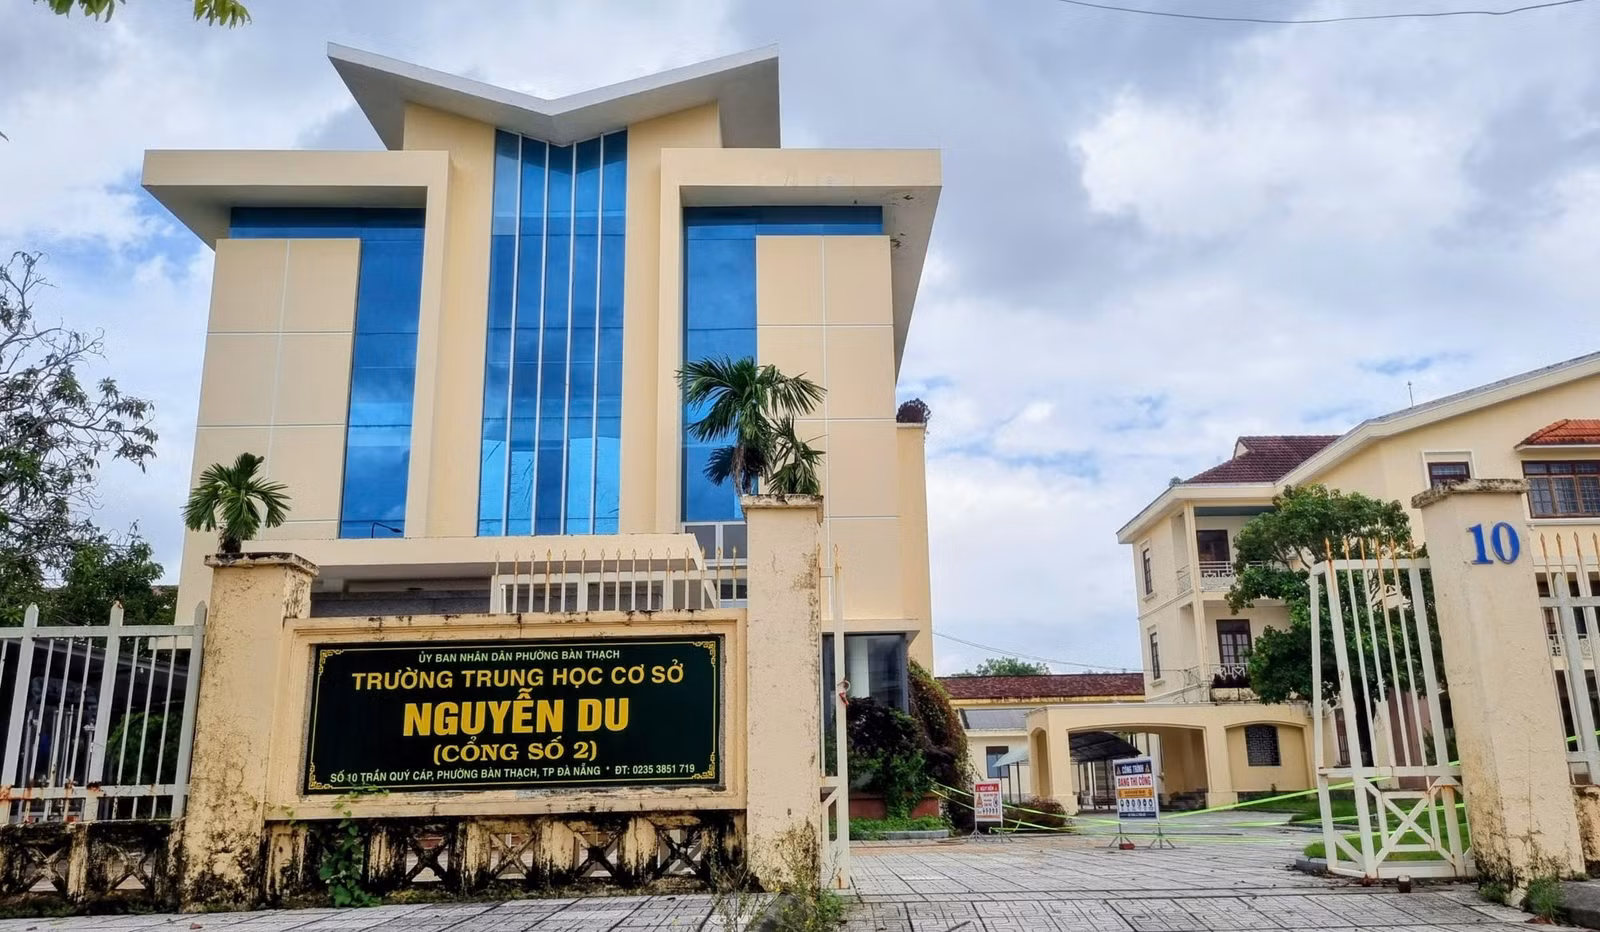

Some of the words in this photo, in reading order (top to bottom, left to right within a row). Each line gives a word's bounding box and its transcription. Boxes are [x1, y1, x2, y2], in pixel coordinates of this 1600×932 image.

[1466, 522, 1520, 565] 10
[418, 651, 433, 664] ỦY
[435, 653, 457, 663] BAN
[460, 650, 488, 662] NHÂN
[491, 651, 513, 662] DÂN
[515, 649, 559, 661] PHƯỜNG
[562, 648, 583, 660] BÀN
[585, 649, 621, 661] THẠCH
[351, 667, 453, 690] TRƯỜNG
[461, 668, 544, 688] TRUNG
[552, 667, 603, 689] HỌC
[611, 663, 645, 685] CƠ
[651, 658, 684, 684] SỞ
[403, 688, 564, 736] NGUYỄN
[577, 697, 630, 732] DU
[433, 736, 520, 766] (CỔNG
[528, 735, 565, 761] SỐ
[573, 740, 598, 762] 2)
[330, 769, 345, 783] SỐ
[347, 773, 358, 783] 10
[389, 769, 411, 782] QUÝ
[412, 768, 435, 782] CÁP,
[436, 767, 478, 781] PHƯỜNG
[481, 767, 501, 779] BÀN
[504, 767, 540, 780] THẠCH,
[542, 767, 554, 777] TP
[557, 765, 571, 777] ĐÀ
[573, 763, 601, 776] NẴNG
[614, 765, 630, 775] ĐT:
[632, 765, 654, 775] 0235
[655, 764, 676, 774] 3851
[679, 763, 696, 774] 719
